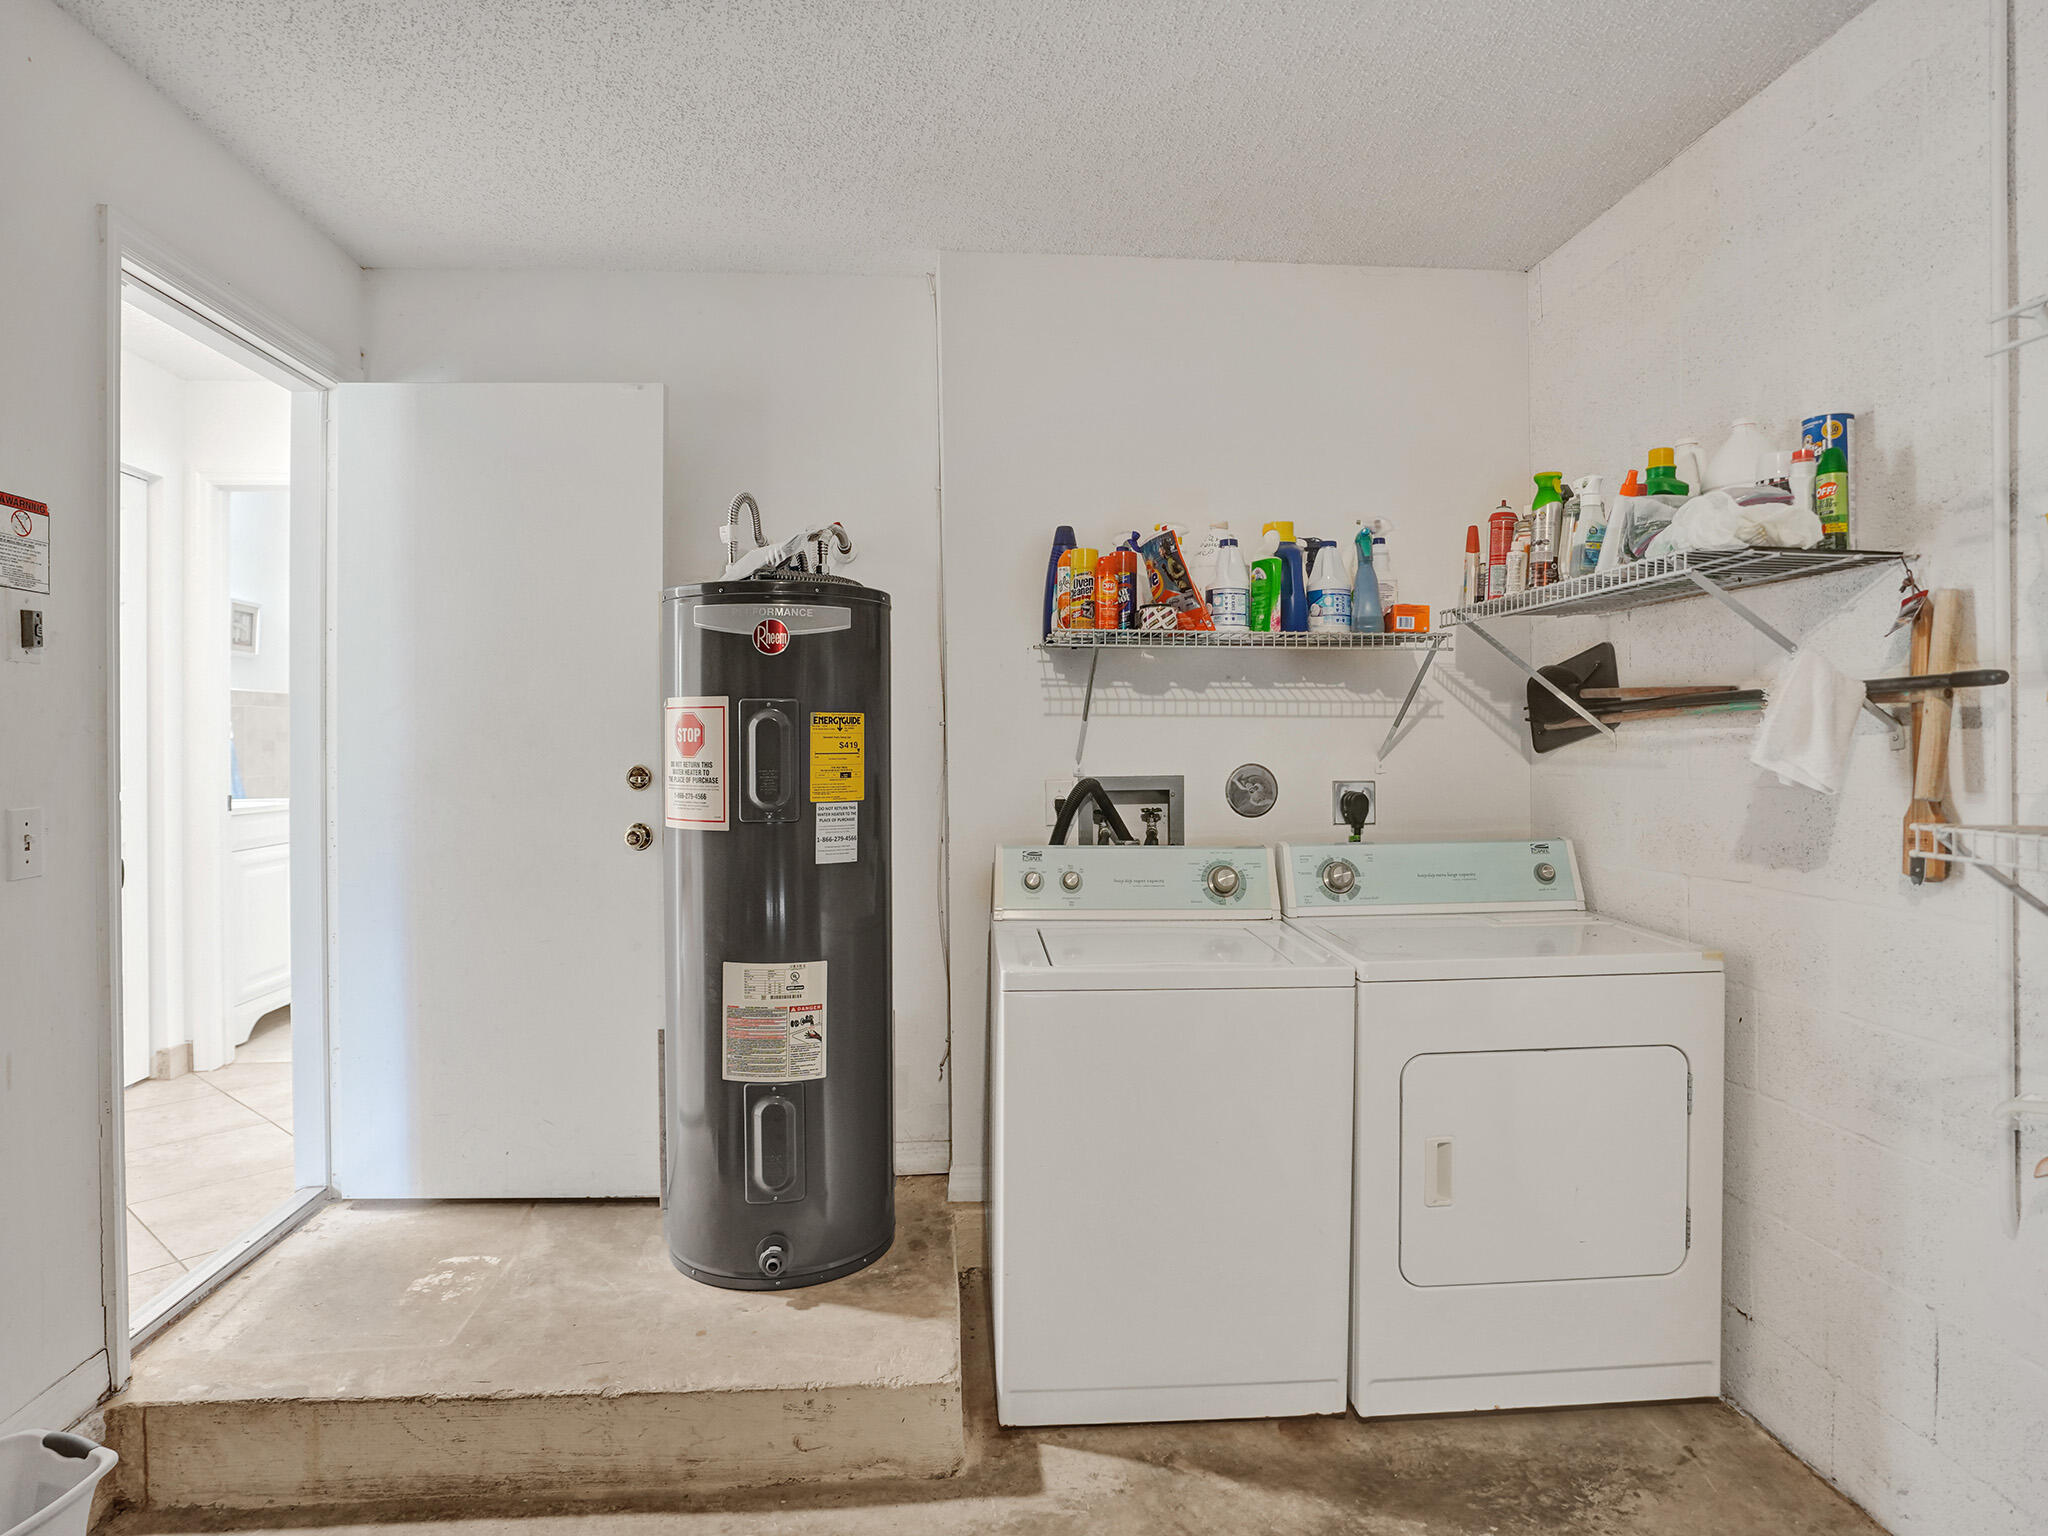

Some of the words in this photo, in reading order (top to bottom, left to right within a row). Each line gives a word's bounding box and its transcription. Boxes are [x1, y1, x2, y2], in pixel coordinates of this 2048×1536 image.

[1816, 485, 1837, 497] OFF!
[6, 495, 45, 513] WARNING
[1073, 577, 1094, 589] Oven
[758, 620, 787, 649] Rheem
[677, 727, 701, 743] STOP
